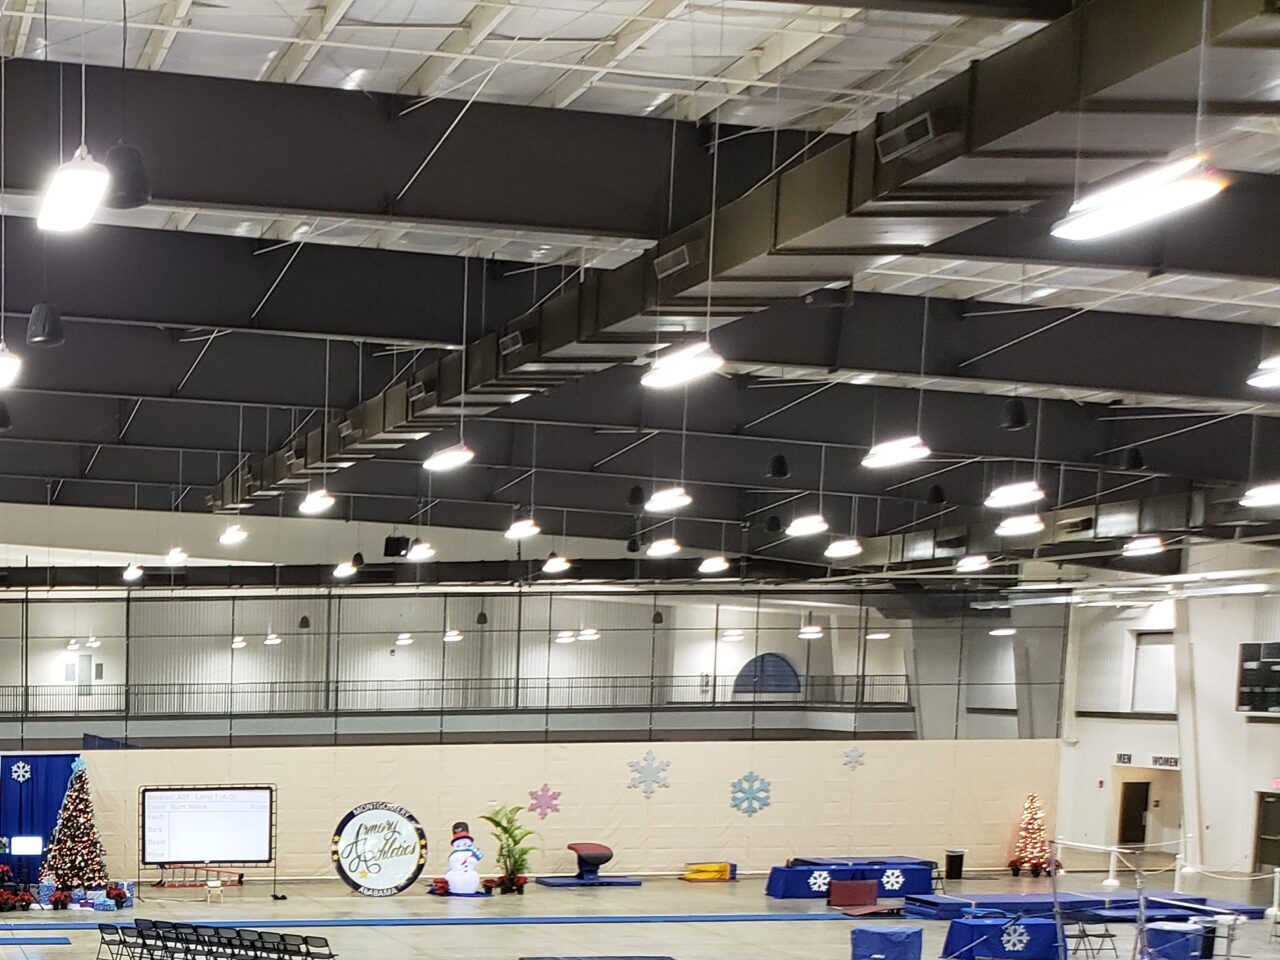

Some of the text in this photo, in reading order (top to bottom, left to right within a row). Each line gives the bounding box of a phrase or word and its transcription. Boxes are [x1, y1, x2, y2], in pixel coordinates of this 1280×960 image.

[1116, 754, 1132, 764] MEN
[1152, 756, 1178, 767] WOMEN
[358, 886, 398, 897] ALABAMA
